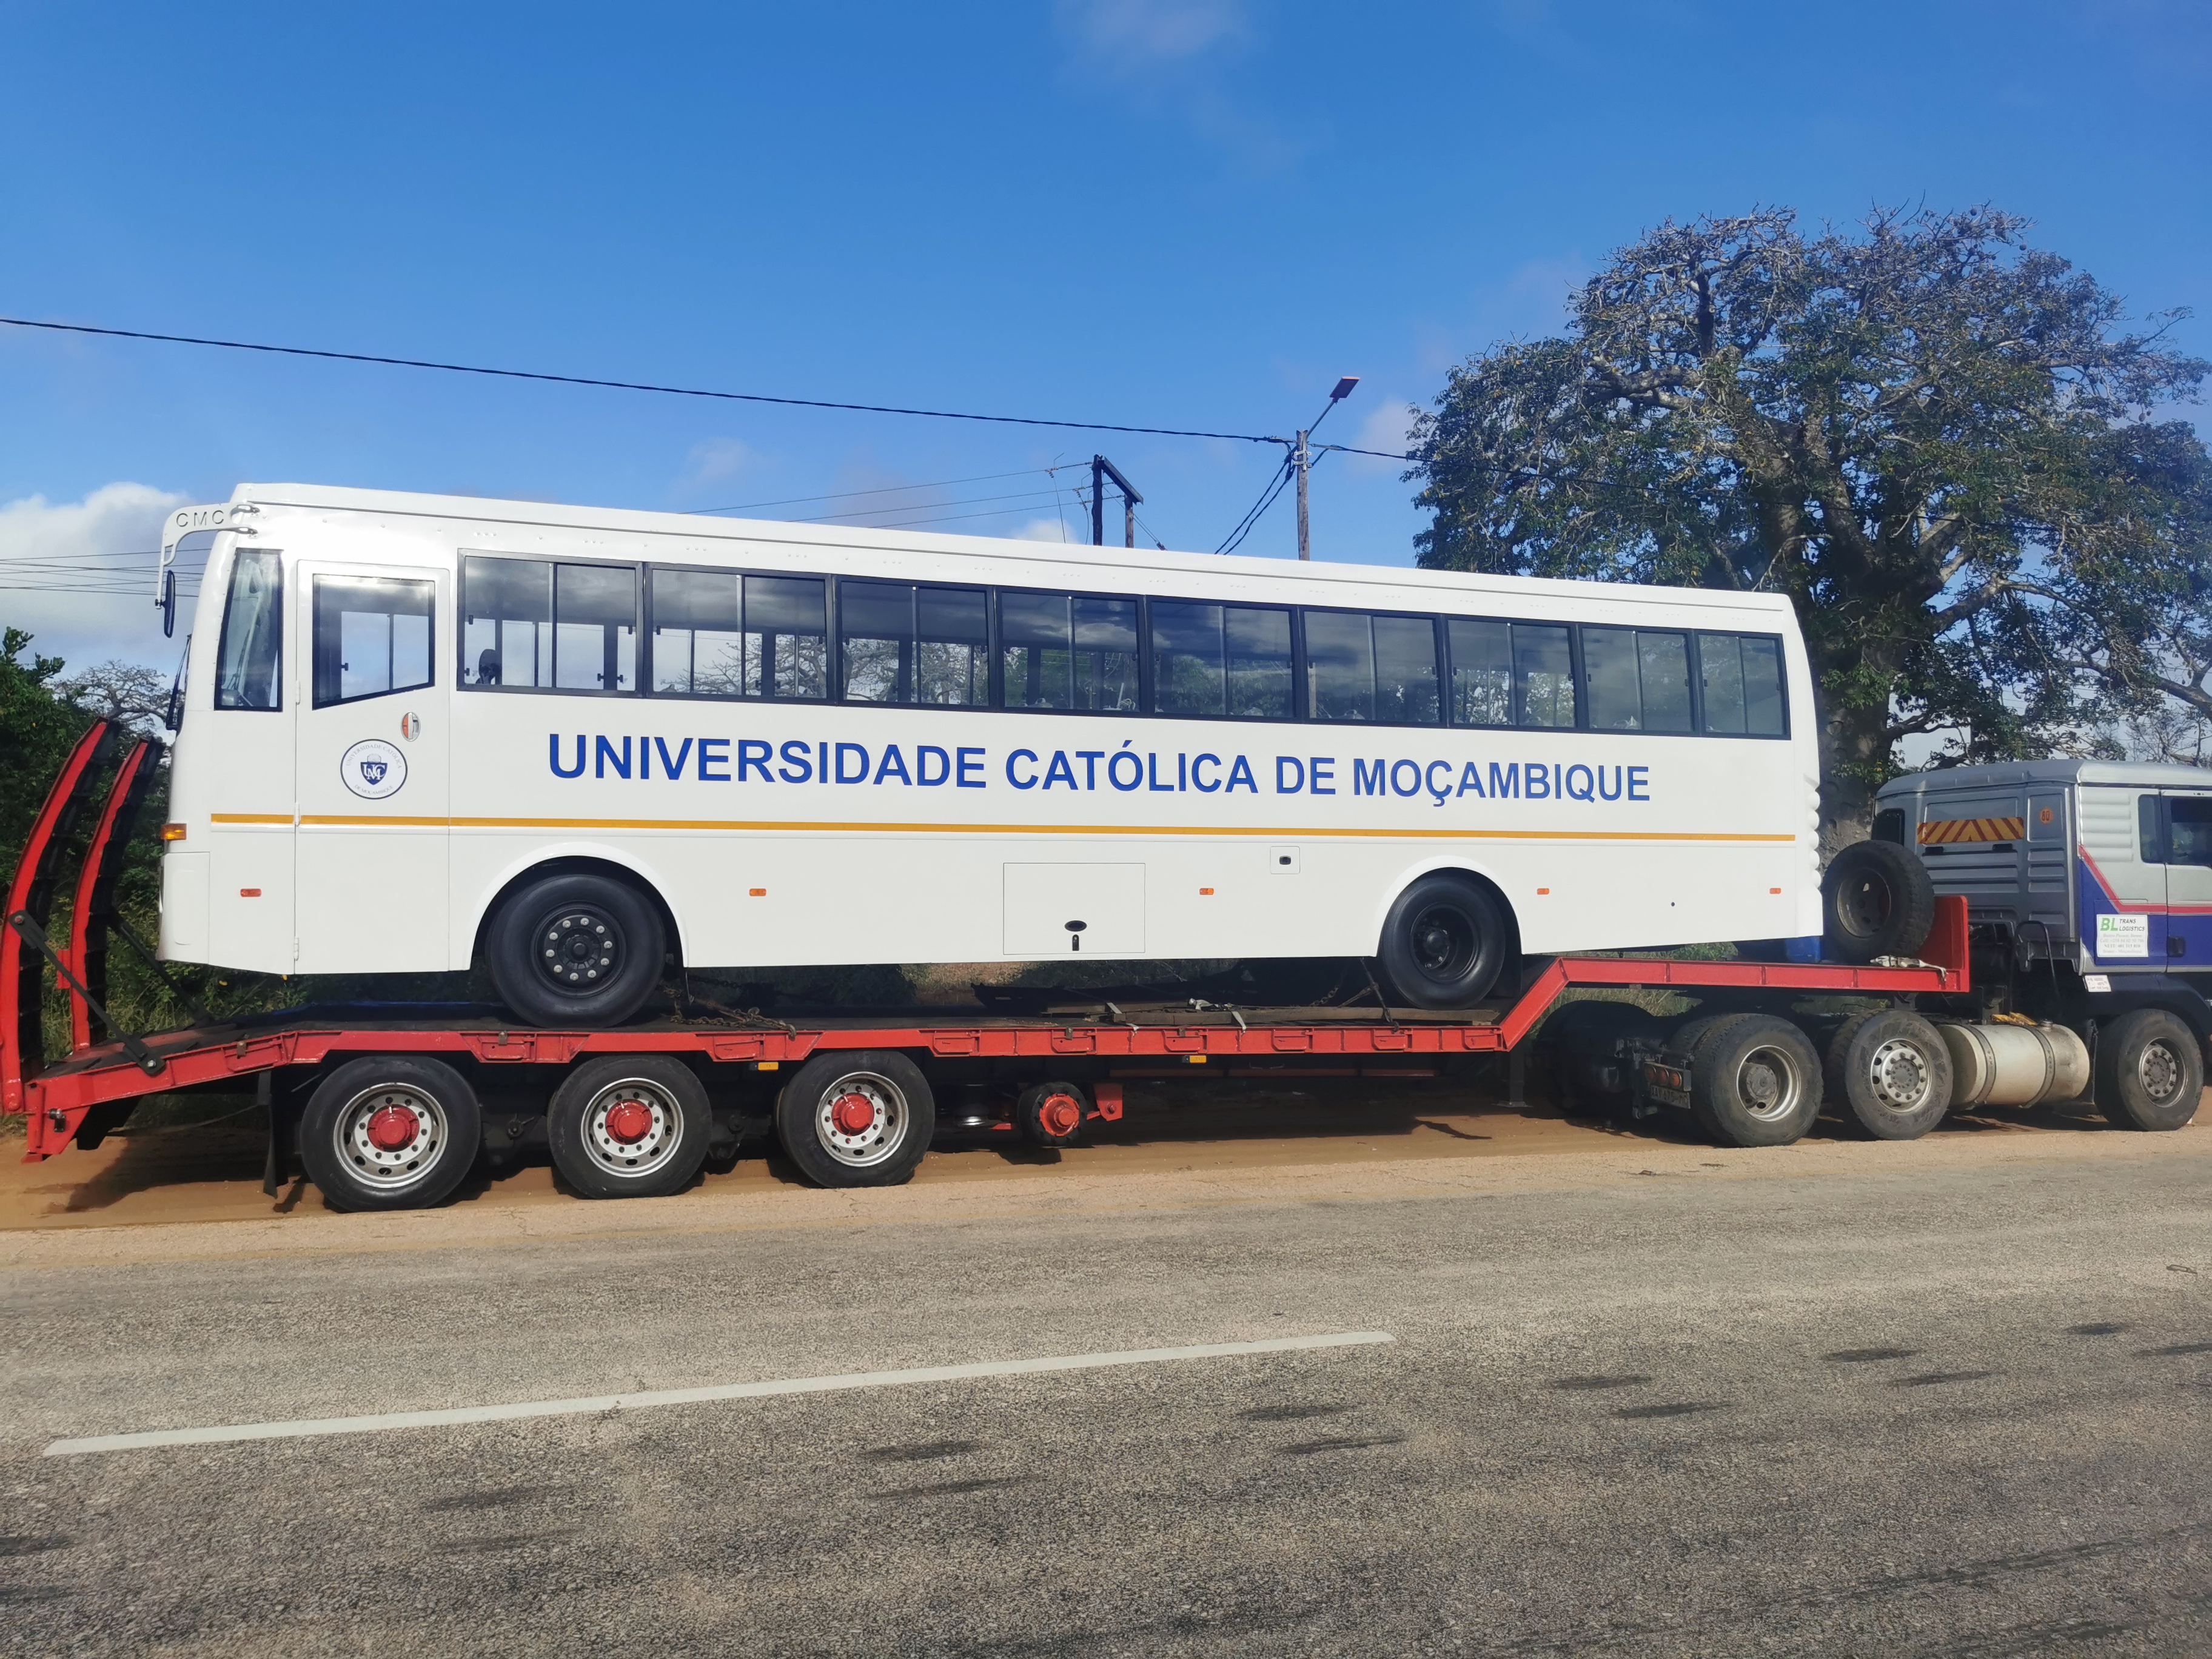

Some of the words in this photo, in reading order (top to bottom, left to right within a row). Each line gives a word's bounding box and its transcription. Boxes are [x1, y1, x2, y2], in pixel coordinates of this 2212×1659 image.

[176, 509, 224, 528] CMC
[346, 743, 381, 766] UNIVERSIDADE
[383, 746, 403, 769] CATÓLICA
[550, 734, 987, 789] UNIVERSIDADE
[1005, 740, 1259, 794] CATÓLICA
[1276, 756, 1338, 796] DE
[1355, 759, 1651, 806] MOÇAMBIQUE
[2100, 917, 2118, 931] BL
